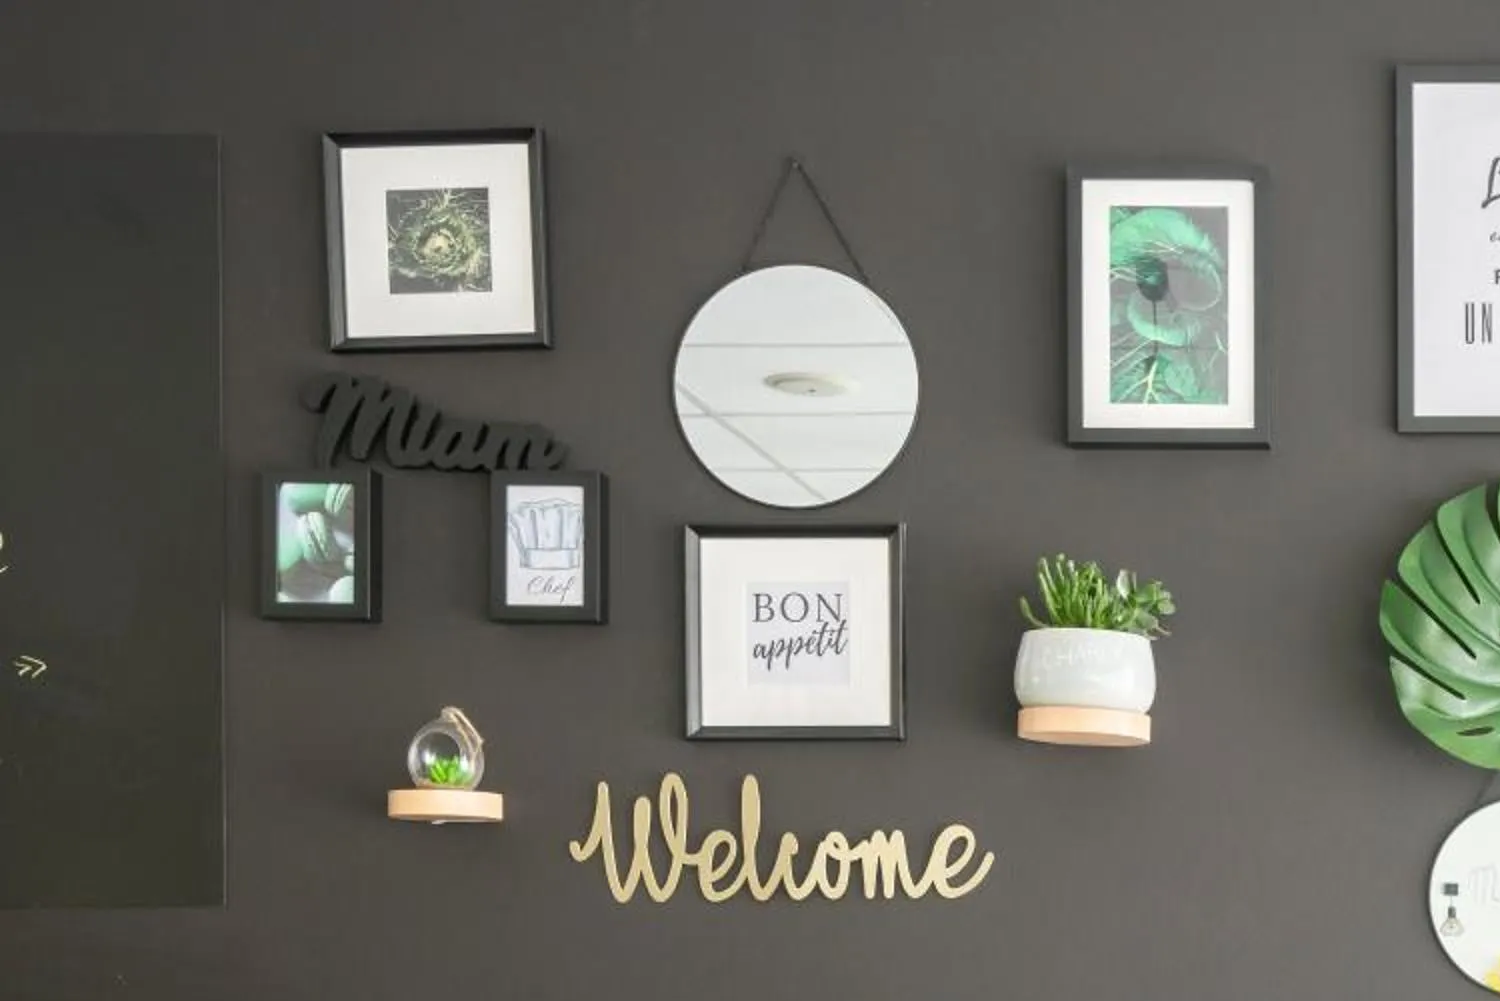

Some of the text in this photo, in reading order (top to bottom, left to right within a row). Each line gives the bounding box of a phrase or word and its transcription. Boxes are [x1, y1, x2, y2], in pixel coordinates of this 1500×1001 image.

[1464, 302, 1494, 344] UN
[300, 371, 569, 470] Miam
[526, 575, 576, 604] Chef
[751, 592, 843, 623] BON
[752, 619, 848, 672] appétit
[569, 772, 995, 904] Welcome
